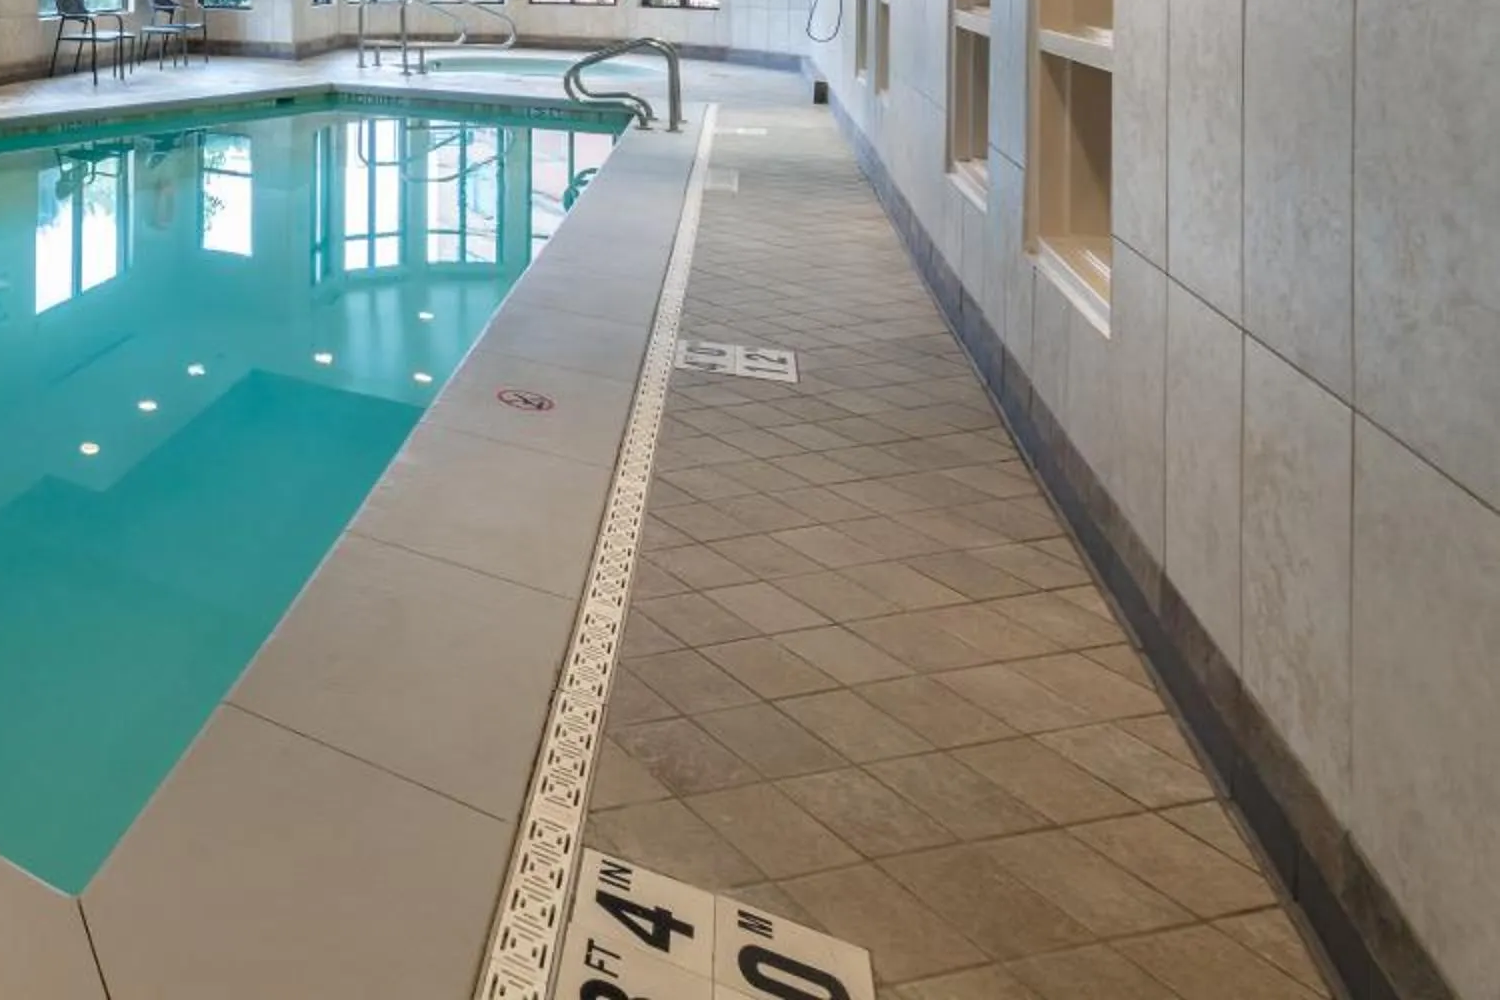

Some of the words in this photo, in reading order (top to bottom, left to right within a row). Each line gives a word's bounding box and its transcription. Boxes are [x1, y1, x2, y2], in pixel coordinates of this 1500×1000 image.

[598, 859, 633, 891] IN
[596, 889, 695, 953] 4
[738, 909, 774, 939] M
[585, 938, 621, 978] FT
